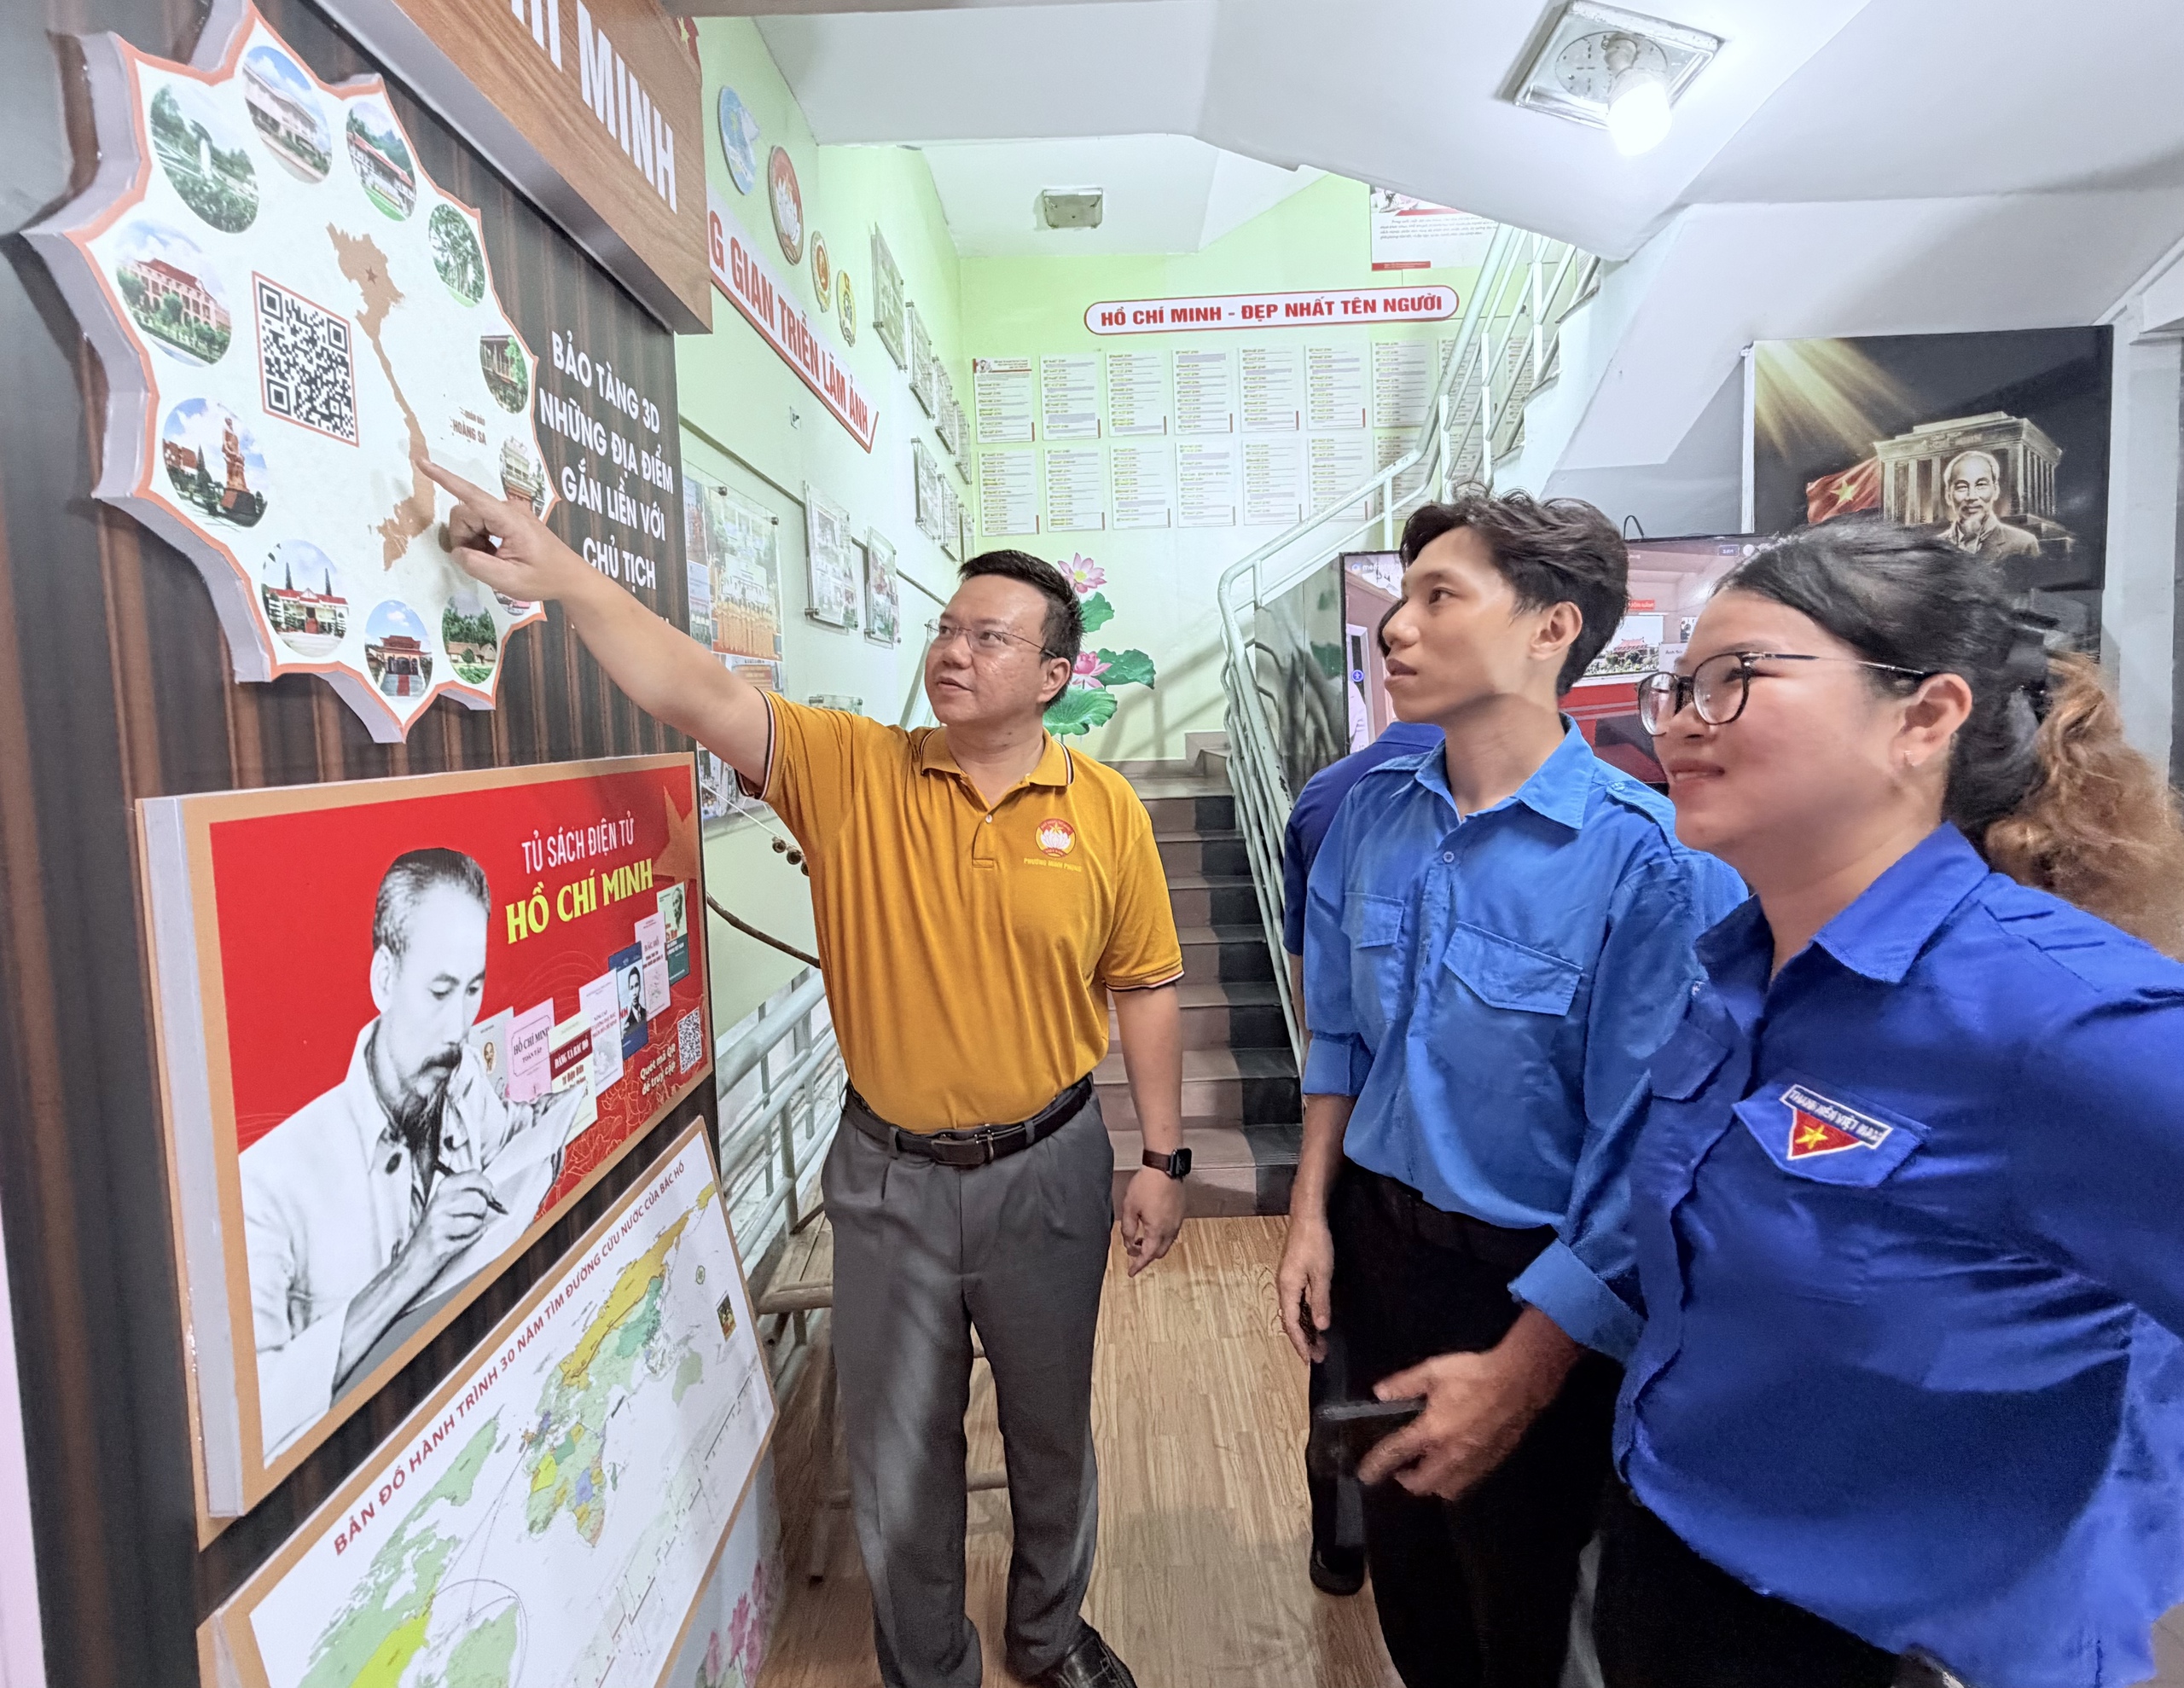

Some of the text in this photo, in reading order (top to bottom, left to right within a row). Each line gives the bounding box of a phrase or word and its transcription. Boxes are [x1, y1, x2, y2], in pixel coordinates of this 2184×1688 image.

[577, 0, 677, 214] MINH
[730, 236, 775, 331] GIAN
[822, 350, 847, 413] LÃM
[849, 374, 869, 438] ẢNH
[1101, 306, 1126, 327] HỒ
[1133, 306, 1165, 325] CHÍ
[1170, 306, 1222, 323] MINH
[1241, 304, 1279, 322] ĐẸP
[1285, 296, 1334, 317] NHẤT
[1341, 297, 1377, 315] TÊN
[1383, 293, 1442, 312] NGƯỜI
[552, 329, 660, 434] BẢO TÀNG 3D
[539, 387, 674, 494] NHỮNG ĐỊA ĐIỂM
[561, 458, 665, 542] GẮN LIỀN VỚI
[584, 535, 656, 593] CHỦ TỊCH
[521, 809, 634, 874] TỦ SÁCH ĐIỆN TỬ
[505, 858, 653, 944] HỒ CHÍ MINH
[640, 1059, 655, 1081] Quét
[667, 1043, 676, 1058] QR
[334, 1160, 685, 1556] BẢN ĐỒ HÀNH TRÌNH 30 NĂM TÌM ĐƯỜNG CỨU NƯỚC CỦA BÁC HỒ
